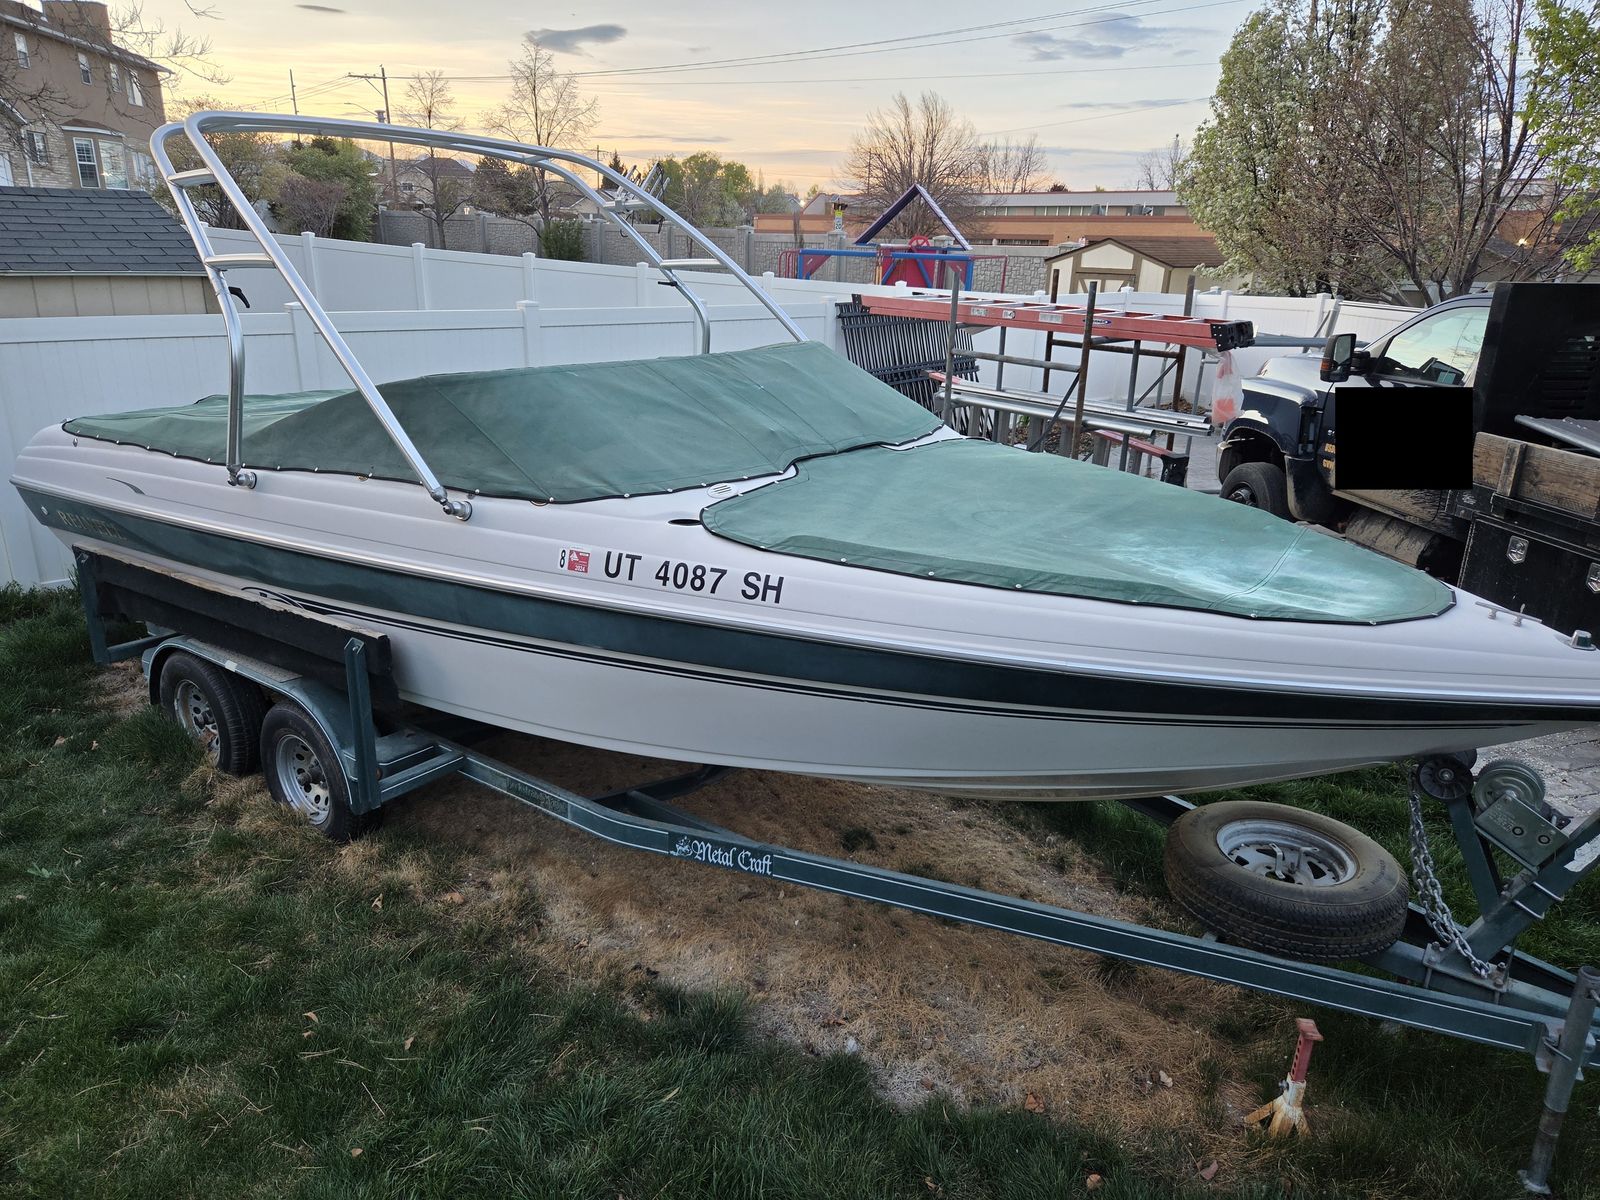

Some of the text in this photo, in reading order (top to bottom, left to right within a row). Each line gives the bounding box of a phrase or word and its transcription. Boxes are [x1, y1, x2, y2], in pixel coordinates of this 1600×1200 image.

[560, 549, 566, 568] 8
[604, 551, 784, 604] UT 4087 SH
[691, 840, 772, 875] Metal Craft
